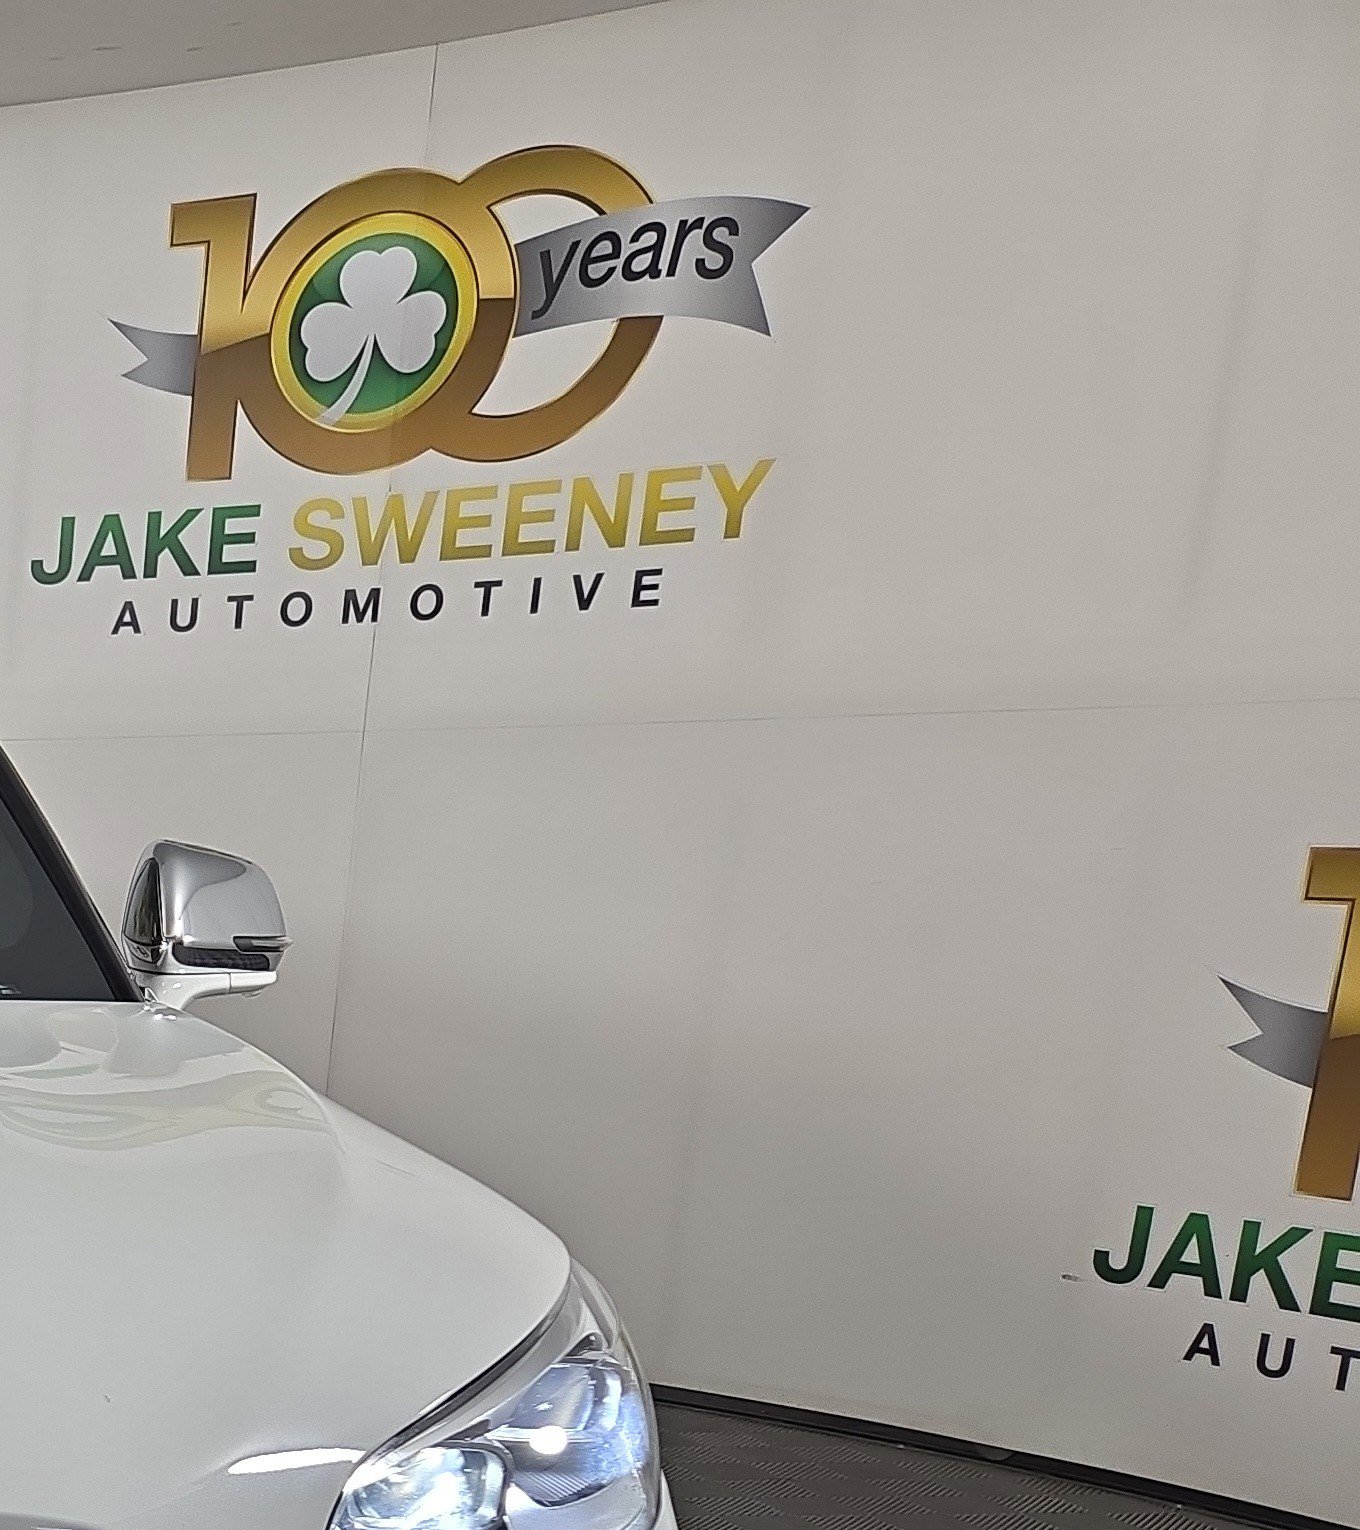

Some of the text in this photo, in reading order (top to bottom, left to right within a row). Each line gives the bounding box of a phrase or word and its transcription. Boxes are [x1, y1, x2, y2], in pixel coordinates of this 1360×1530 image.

[170, 144, 740, 482] 100 years
[30, 459, 776, 586] JAKE SWEENEY
[111, 567, 663, 635] AUTOMOTIVE
[1093, 1204, 1360, 1324] JAKE
